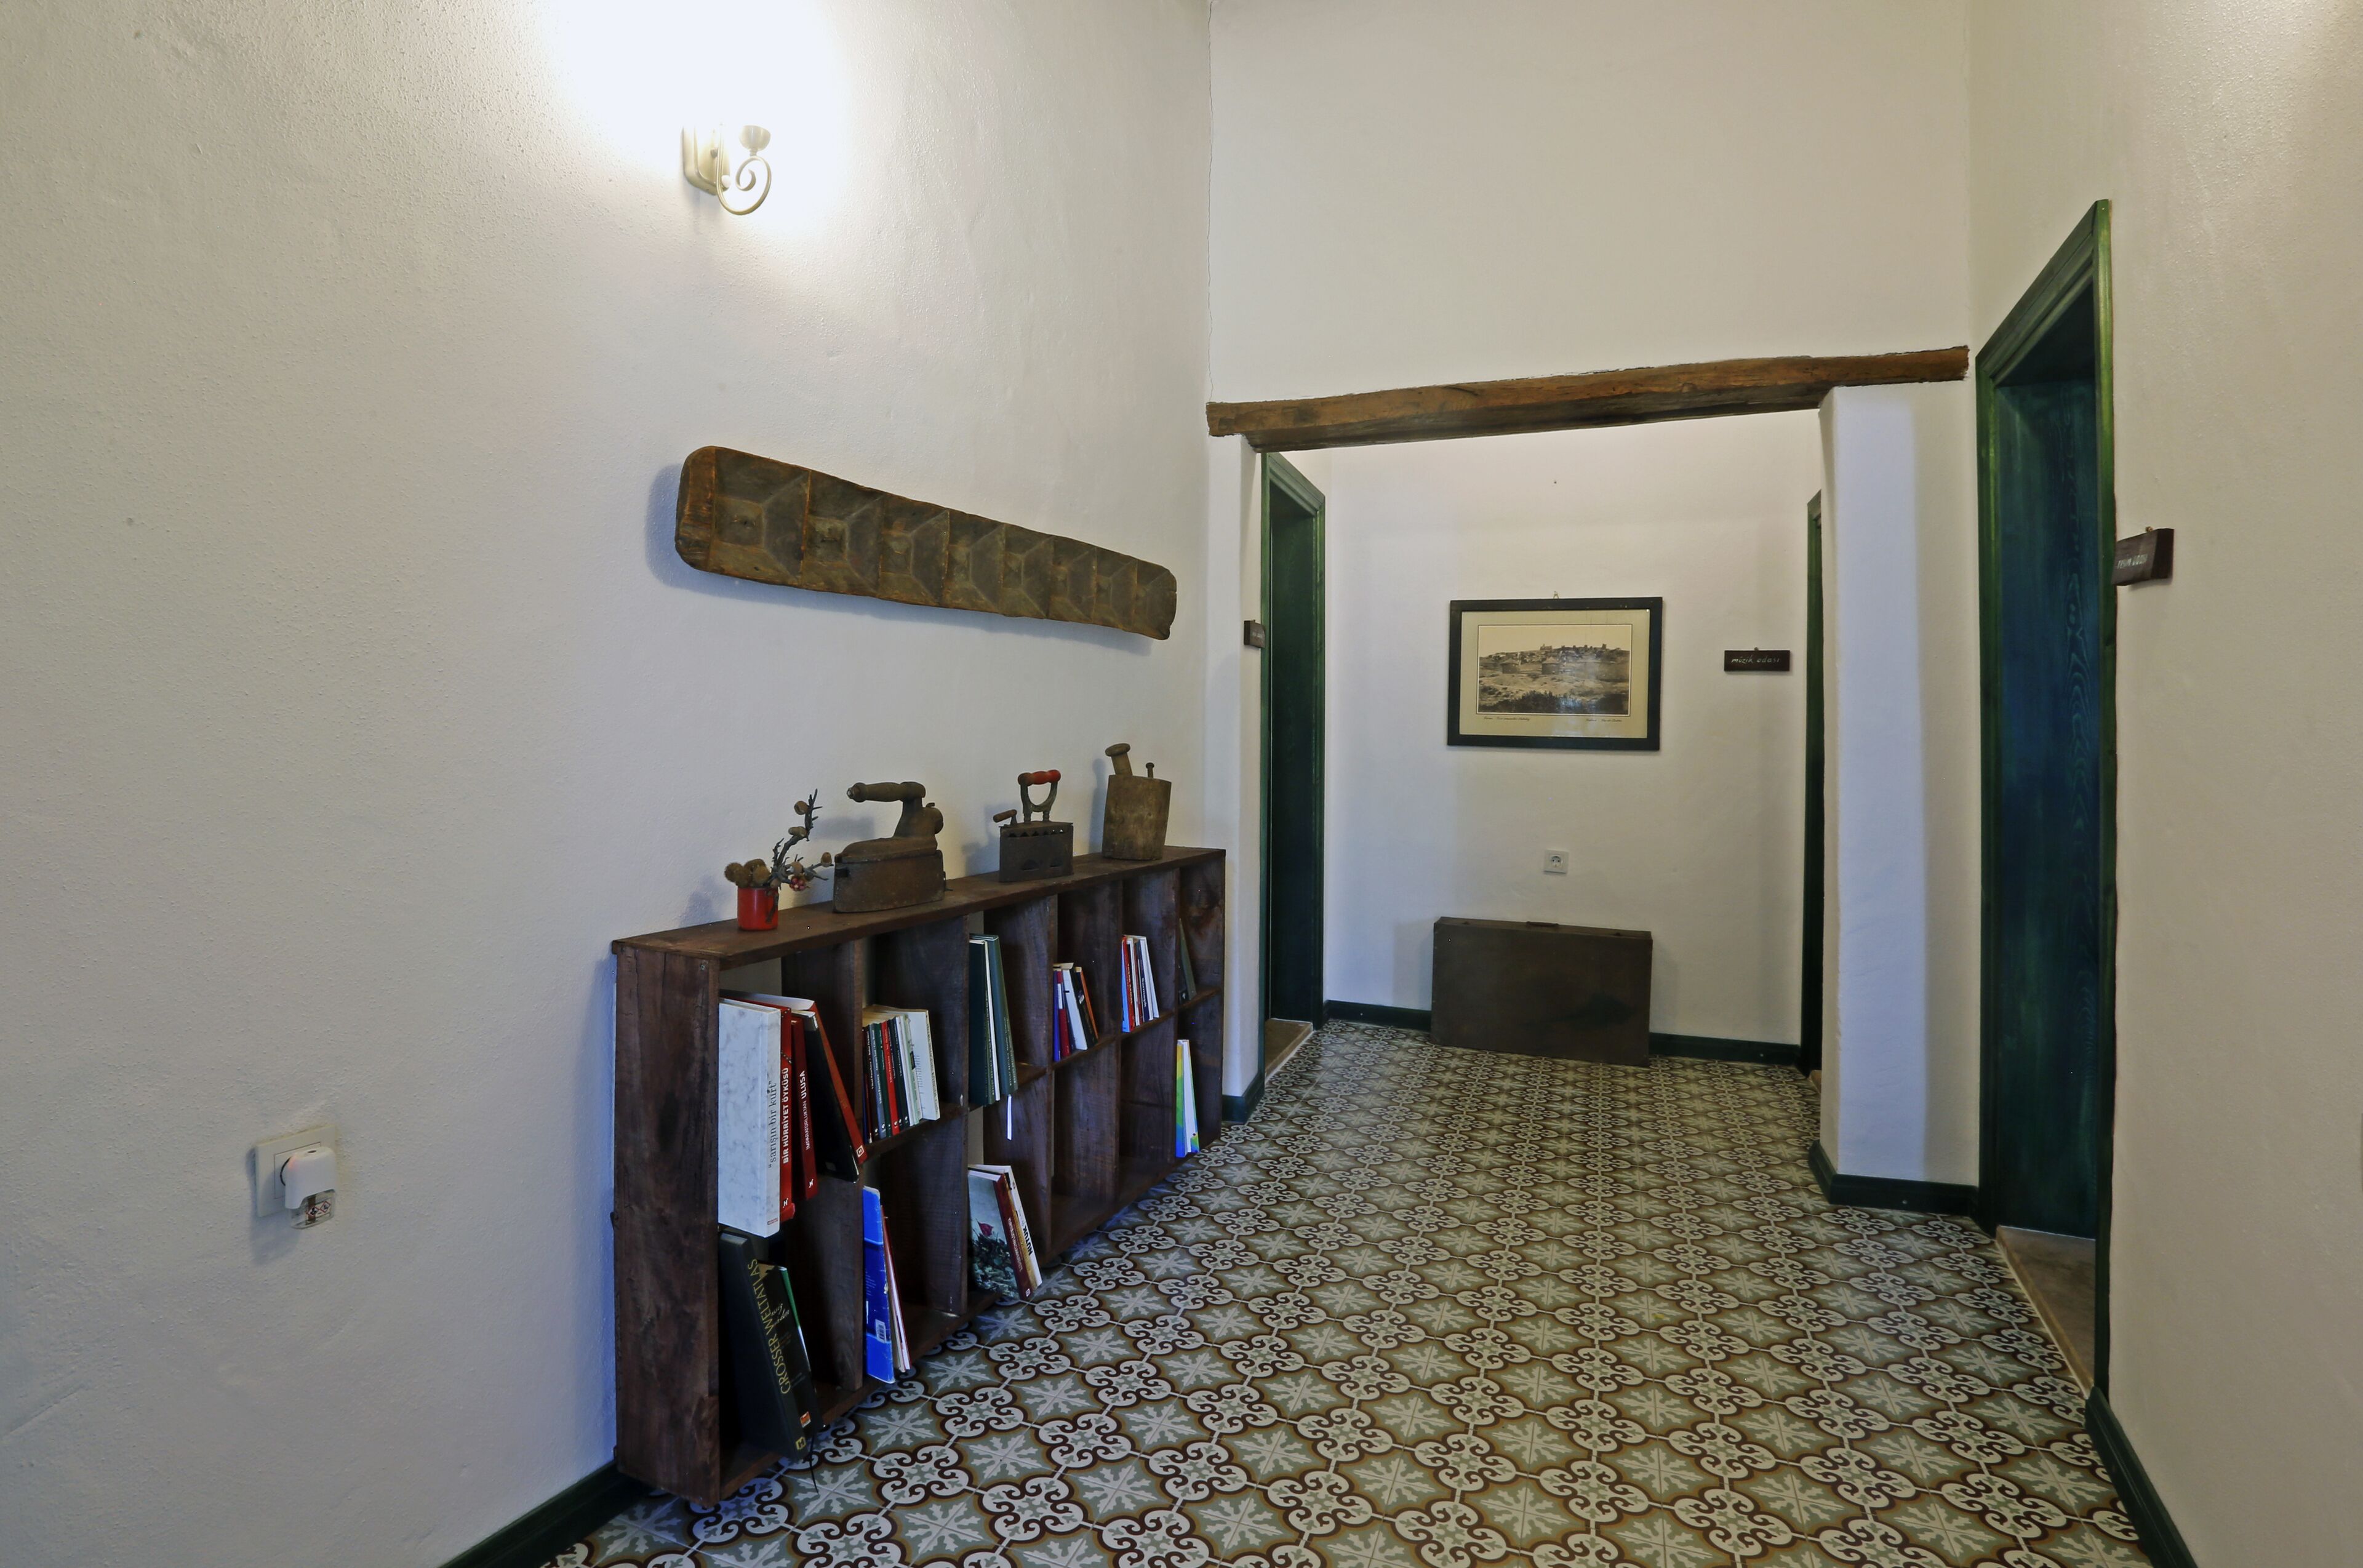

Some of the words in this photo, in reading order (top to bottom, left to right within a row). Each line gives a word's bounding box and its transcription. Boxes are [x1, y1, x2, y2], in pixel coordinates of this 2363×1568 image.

[1731, 654, 1754, 665] müzik
[781, 1067, 789, 1102] ÖYKÜSÜ
[769, 1110, 777, 1126] bir
[781, 1104, 789, 1147] HÜRRİYET
[781, 1148, 789, 1164] BİR
[1023, 1225, 1033, 1256] NUTUK
[747, 1258, 775, 1336] WELTATLAS
[768, 1334, 791, 1394] GROSSER
